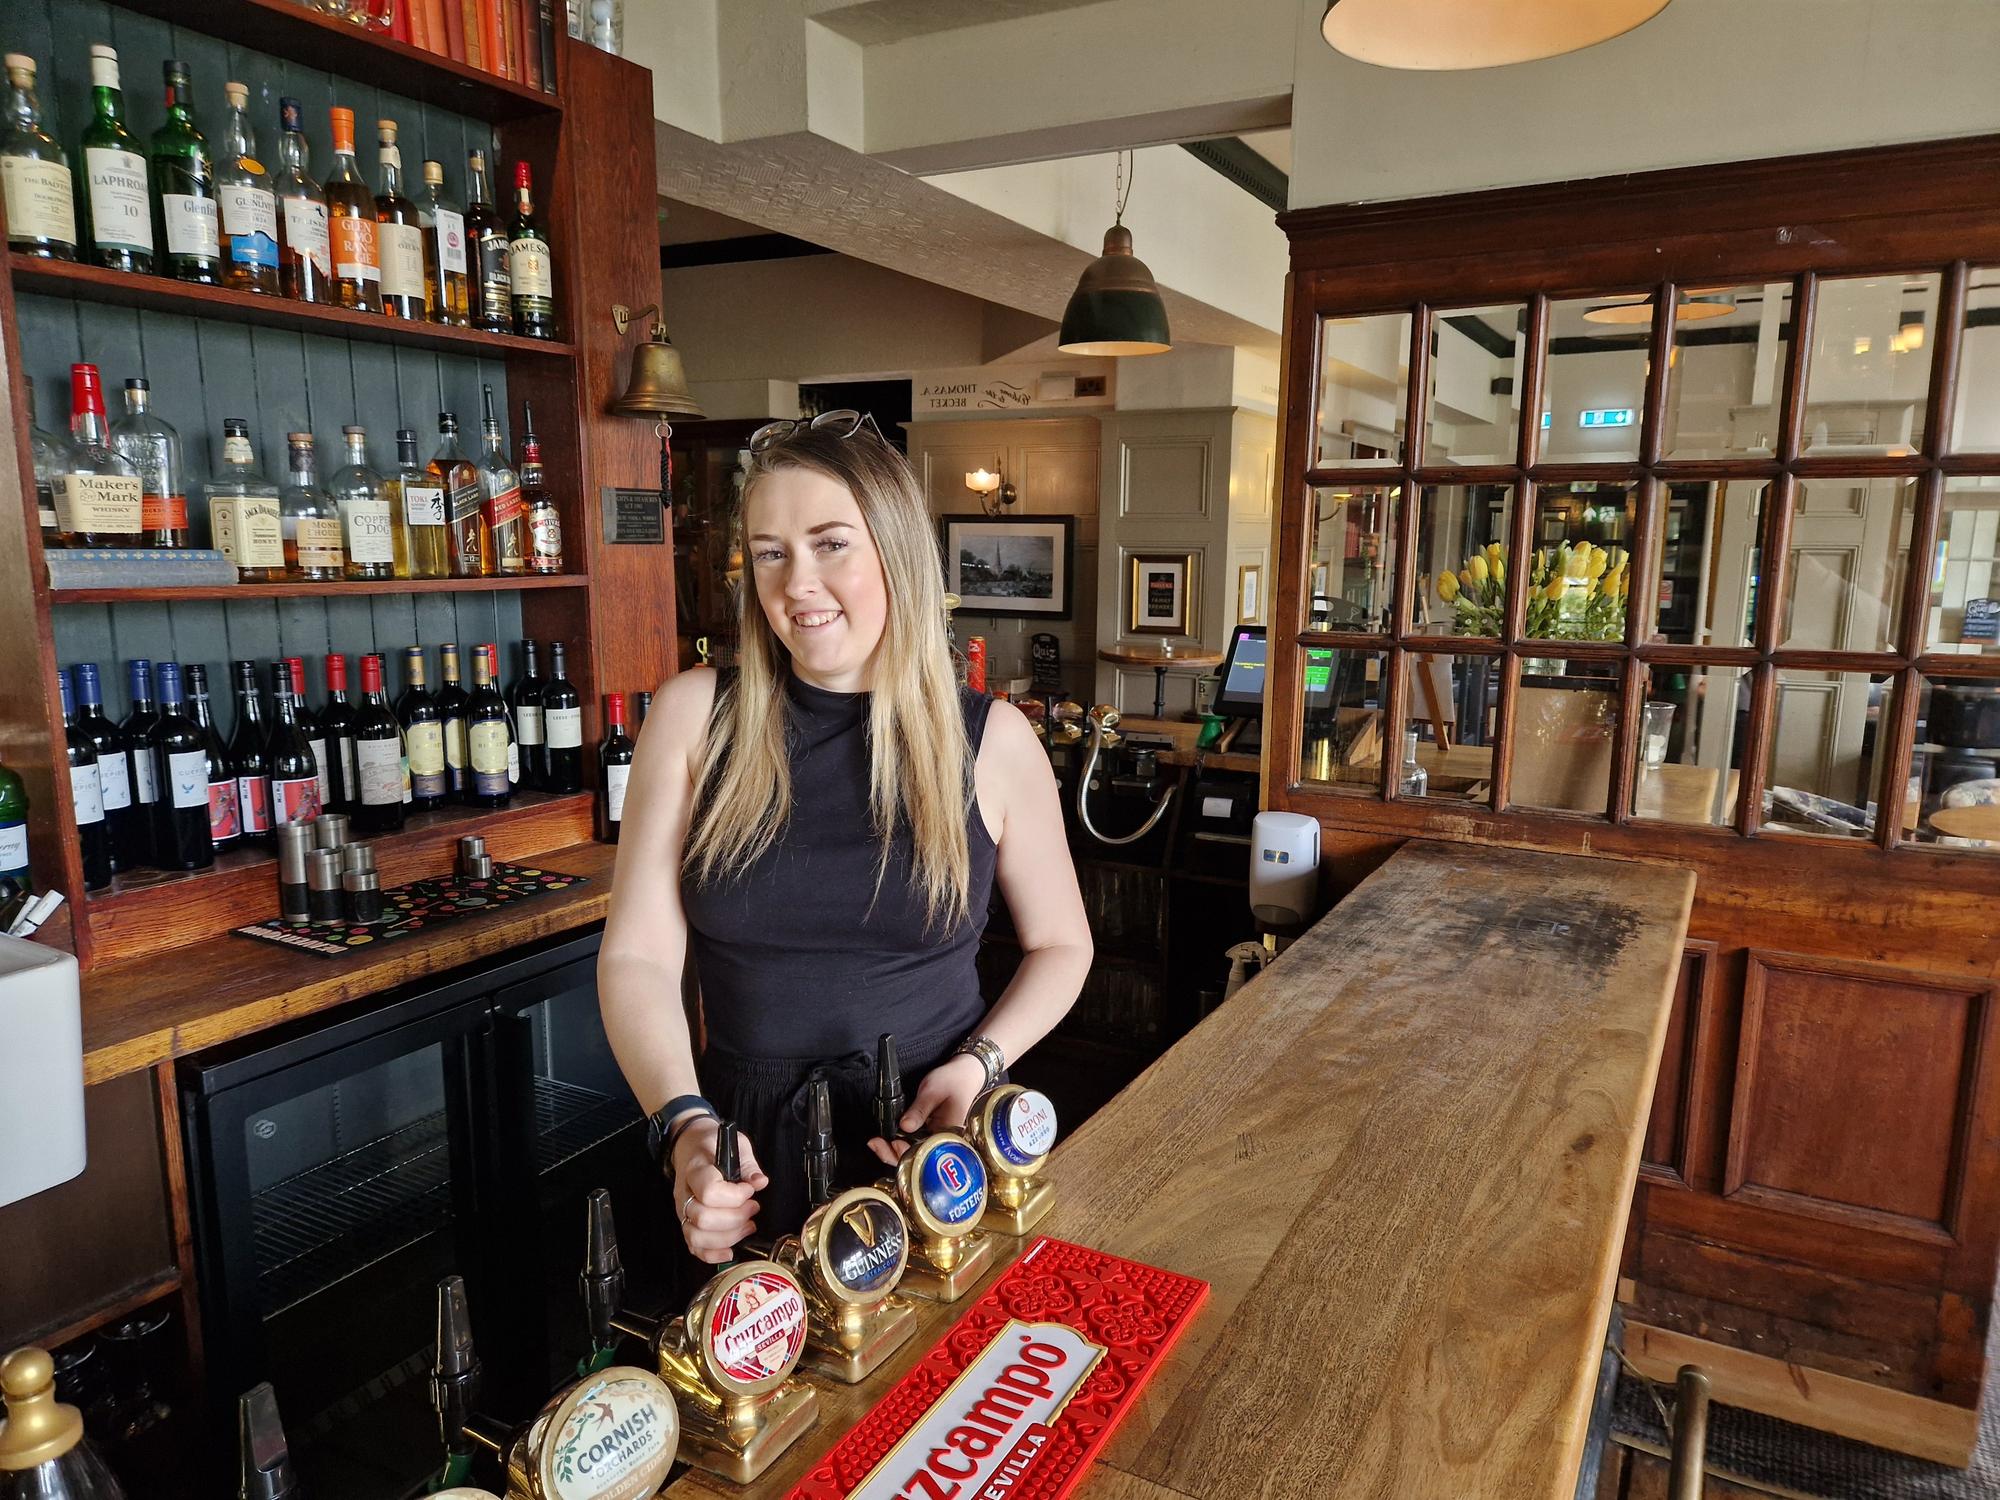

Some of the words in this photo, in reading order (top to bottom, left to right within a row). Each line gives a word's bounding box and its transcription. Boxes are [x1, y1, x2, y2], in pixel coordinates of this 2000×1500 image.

[123, 204, 138, 217] 10
[341, 219, 371, 233] GLEN
[79, 479, 139, 490] Maker's
[97, 491, 138, 502] Mark
[495, 503, 506, 512] RED
[354, 515, 390, 527] COPPE
[367, 524, 390, 535] DOG
[1033, 643, 1057, 659] Quiz
[1017, 1109, 1048, 1138] PERONI
[941, 1158, 961, 1190] F
[948, 1187, 985, 1222] FOSTER'S
[843, 1231, 904, 1282] GUINNESS
[723, 1293, 801, 1358] Cruzcampo
[756, 1330, 784, 1352] SEVILLA
[891, 1343, 1067, 1500] zcampo
[576, 1402, 659, 1475] CORNISH
[595, 1431, 653, 1479] ORCHARDS
[979, 1433, 1047, 1500] EVILLA
